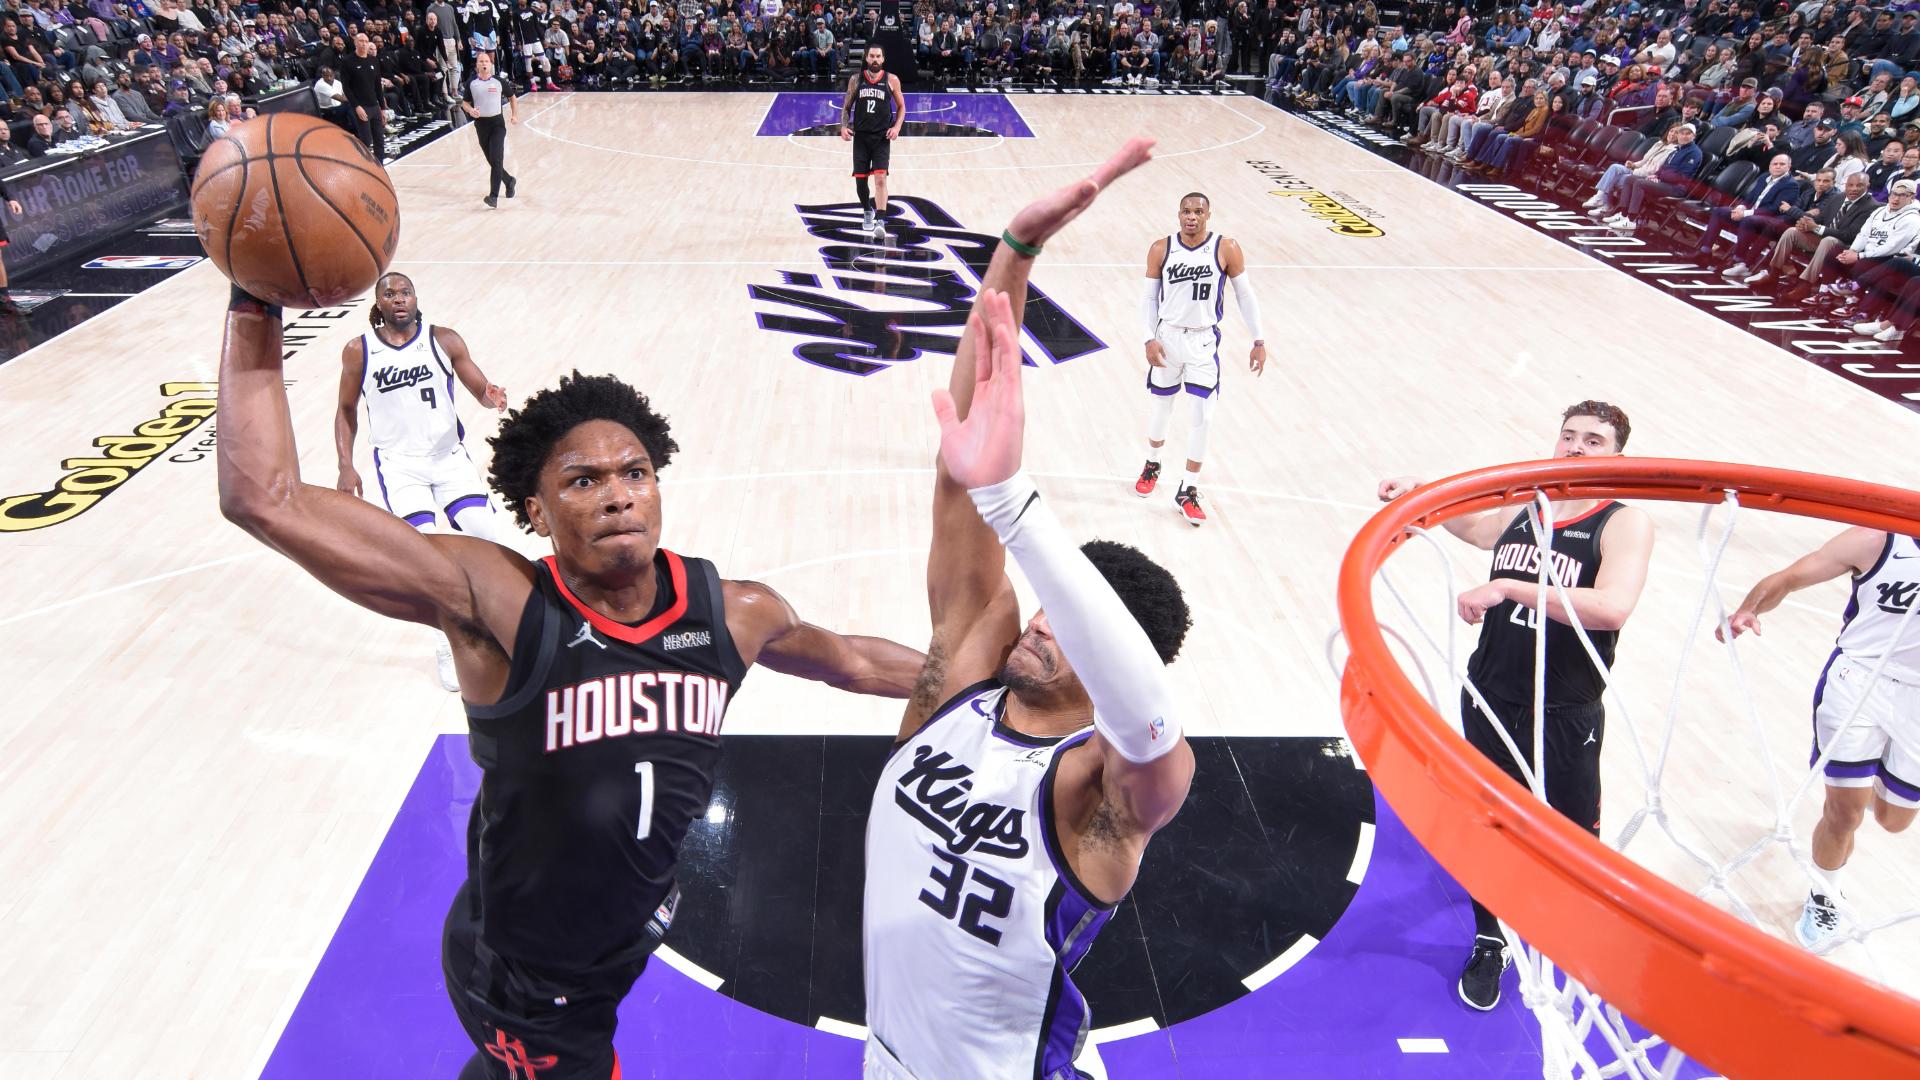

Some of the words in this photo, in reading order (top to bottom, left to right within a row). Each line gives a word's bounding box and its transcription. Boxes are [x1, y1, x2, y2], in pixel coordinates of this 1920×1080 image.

[859, 88, 885, 100] HOUSTON
[867, 100, 876, 113] 12
[50, 165, 108, 208] HOME
[104, 154, 144, 189] FOR
[1456, 184, 1612, 230] PROUD
[1166, 263, 1213, 285] Kings
[1192, 282, 1212, 301] 18
[372, 364, 434, 394] Kings
[420, 387, 437, 409] 9
[663, 630, 711, 643] MEMORIAL
[663, 637, 711, 650] HERMANN
[545, 670, 729, 753] HOUSTON
[634, 760, 655, 840] 1
[918, 843, 1016, 948] 32
